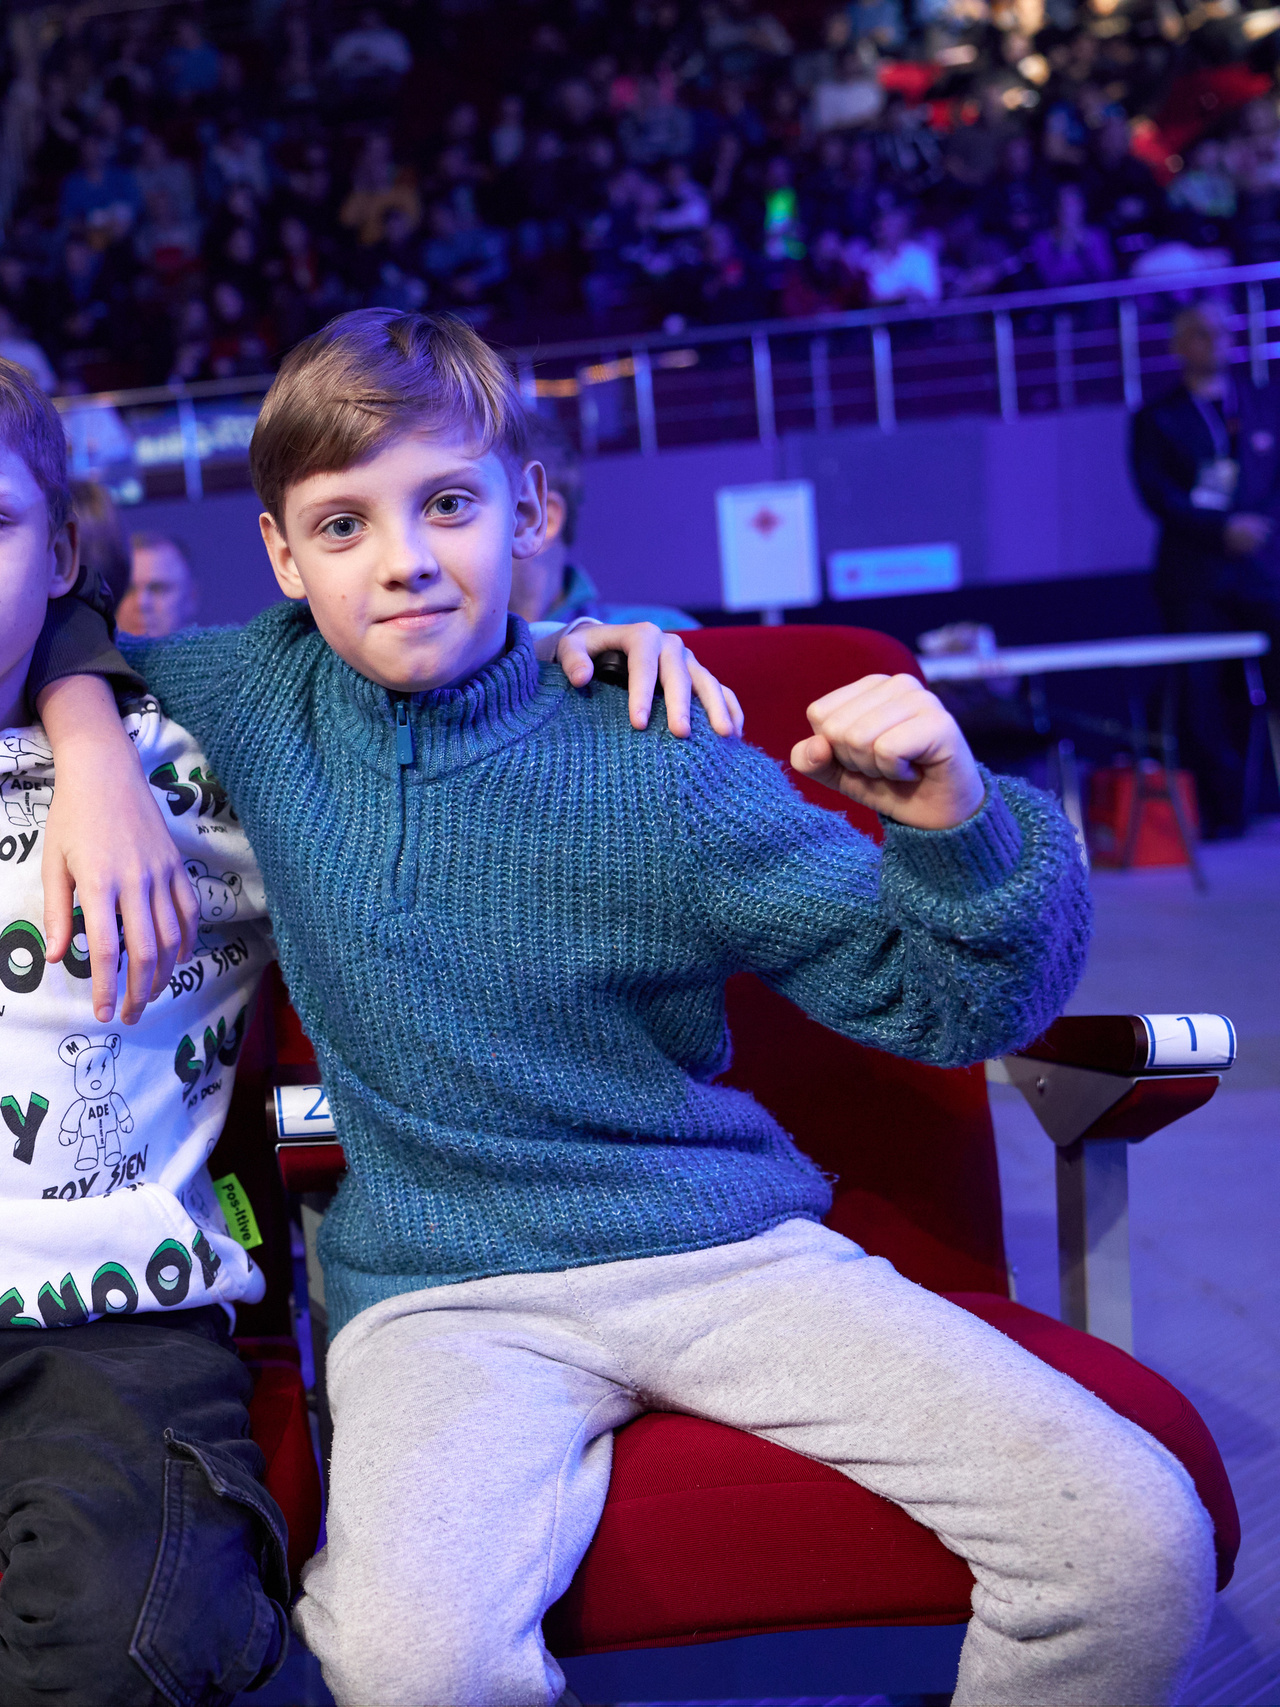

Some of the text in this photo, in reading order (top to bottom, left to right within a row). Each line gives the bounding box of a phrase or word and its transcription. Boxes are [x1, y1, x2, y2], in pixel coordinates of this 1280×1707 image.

[11, 779, 42, 791] ADE
[149, 762, 238, 821] SN
[187, 865, 199, 878] M
[228, 875, 238, 886] S
[170, 960, 204, 999] BOY
[1176, 1016, 1198, 1052] 1
[65, 1041, 80, 1055] M
[111, 1037, 118, 1048] S
[302, 1086, 330, 1121] 2
[88, 1104, 109, 1120] ADE
[41, 1171, 100, 1202] BOY
